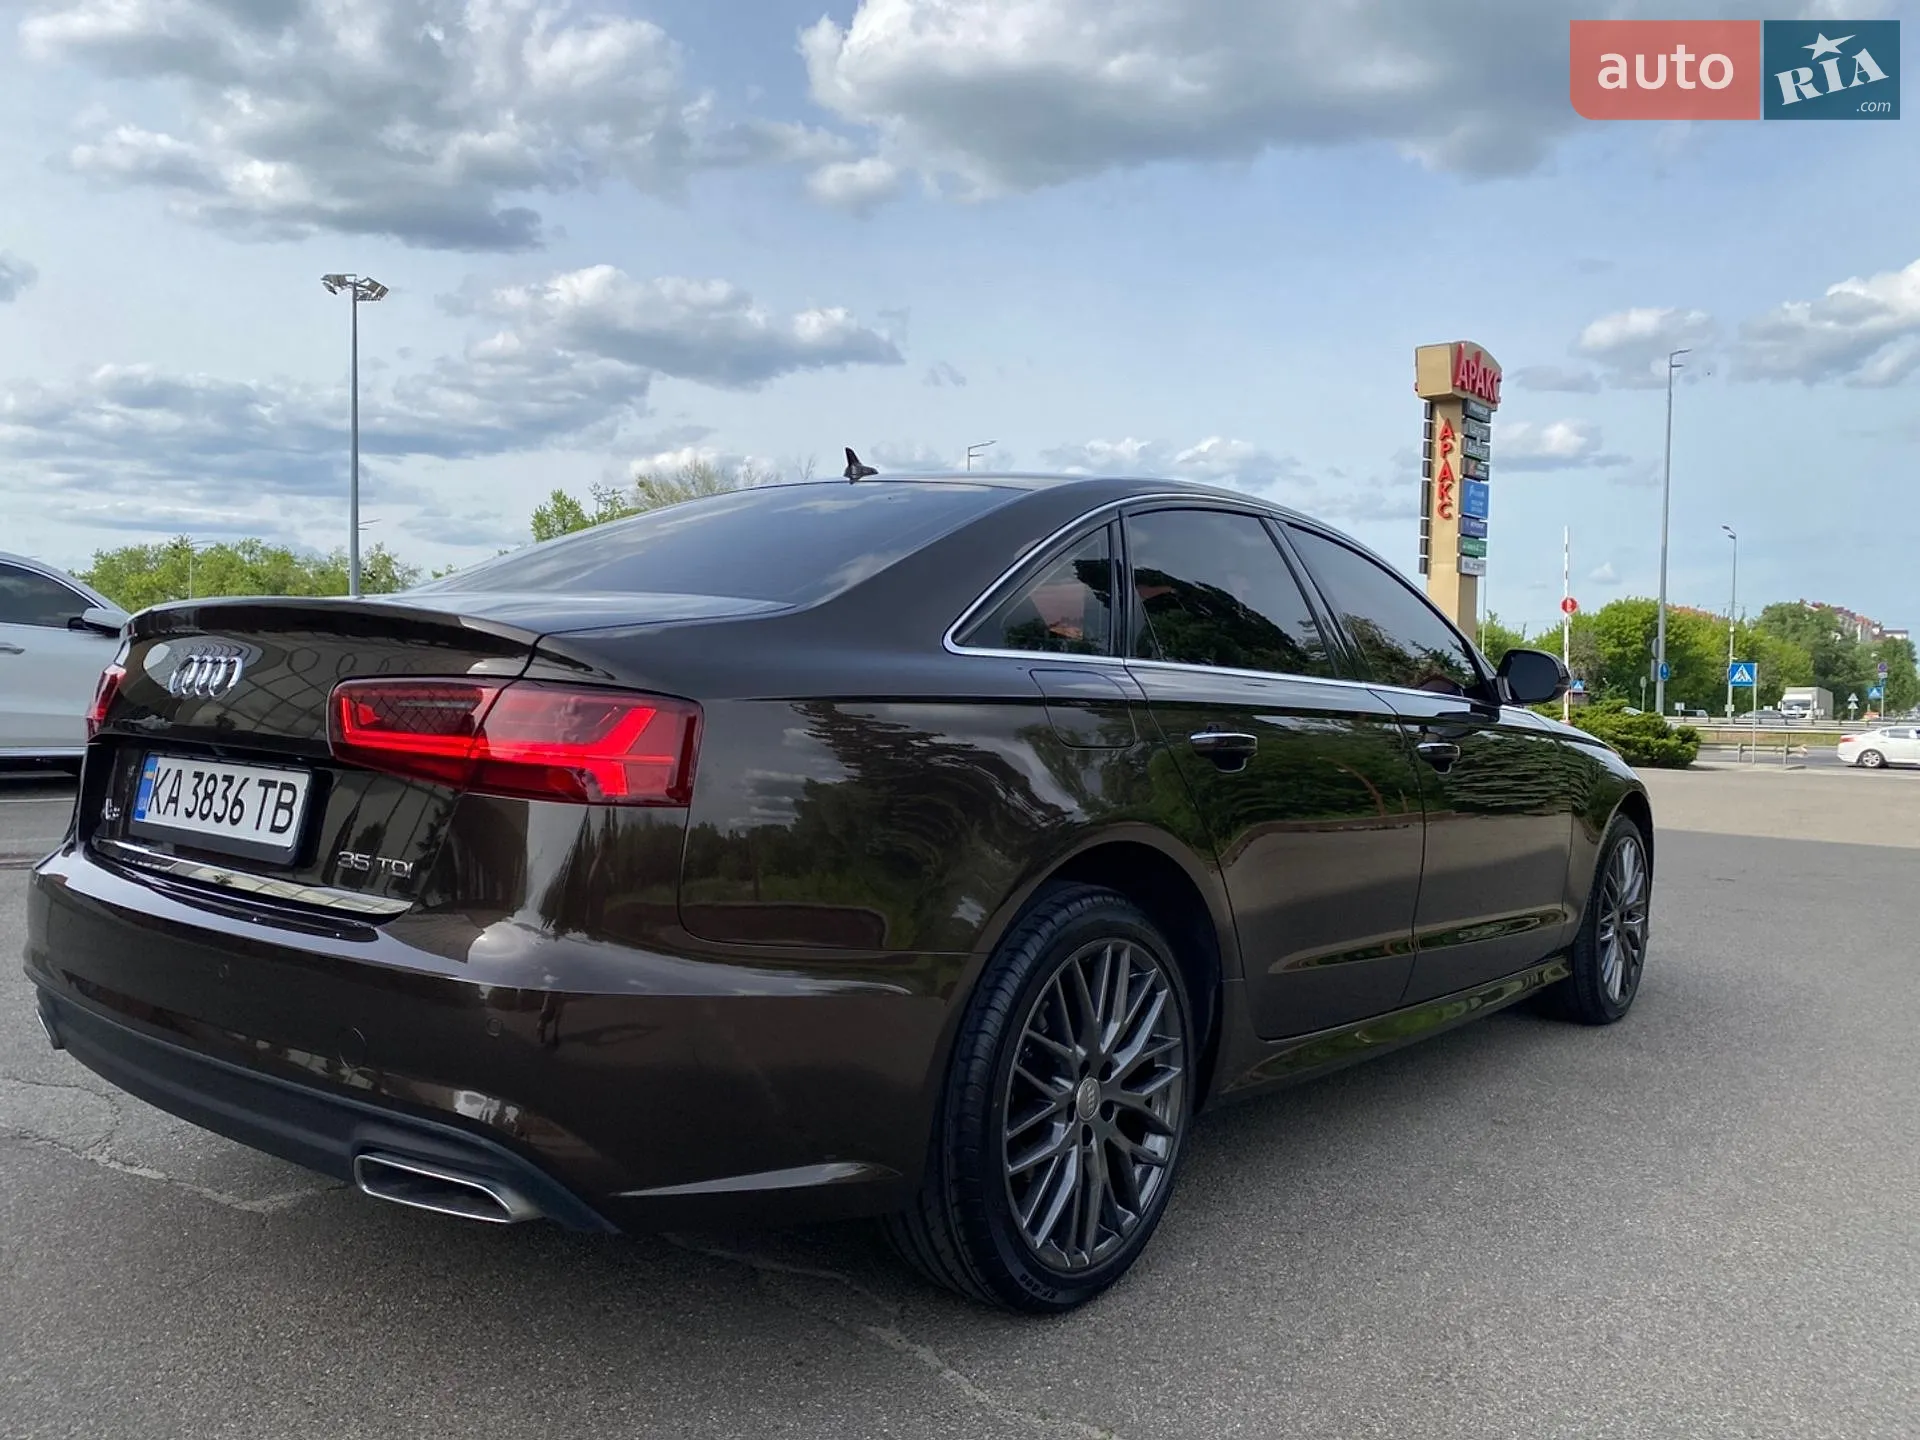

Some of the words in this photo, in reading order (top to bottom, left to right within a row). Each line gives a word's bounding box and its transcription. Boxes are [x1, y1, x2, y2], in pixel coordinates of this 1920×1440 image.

[1437, 417, 1456, 520] АРАКС
[148, 767, 183, 816] KA
[184, 771, 250, 826] 3836
[255, 778, 297, 834] TB
[338, 851, 371, 871] 35
[376, 857, 413, 879] TDI
